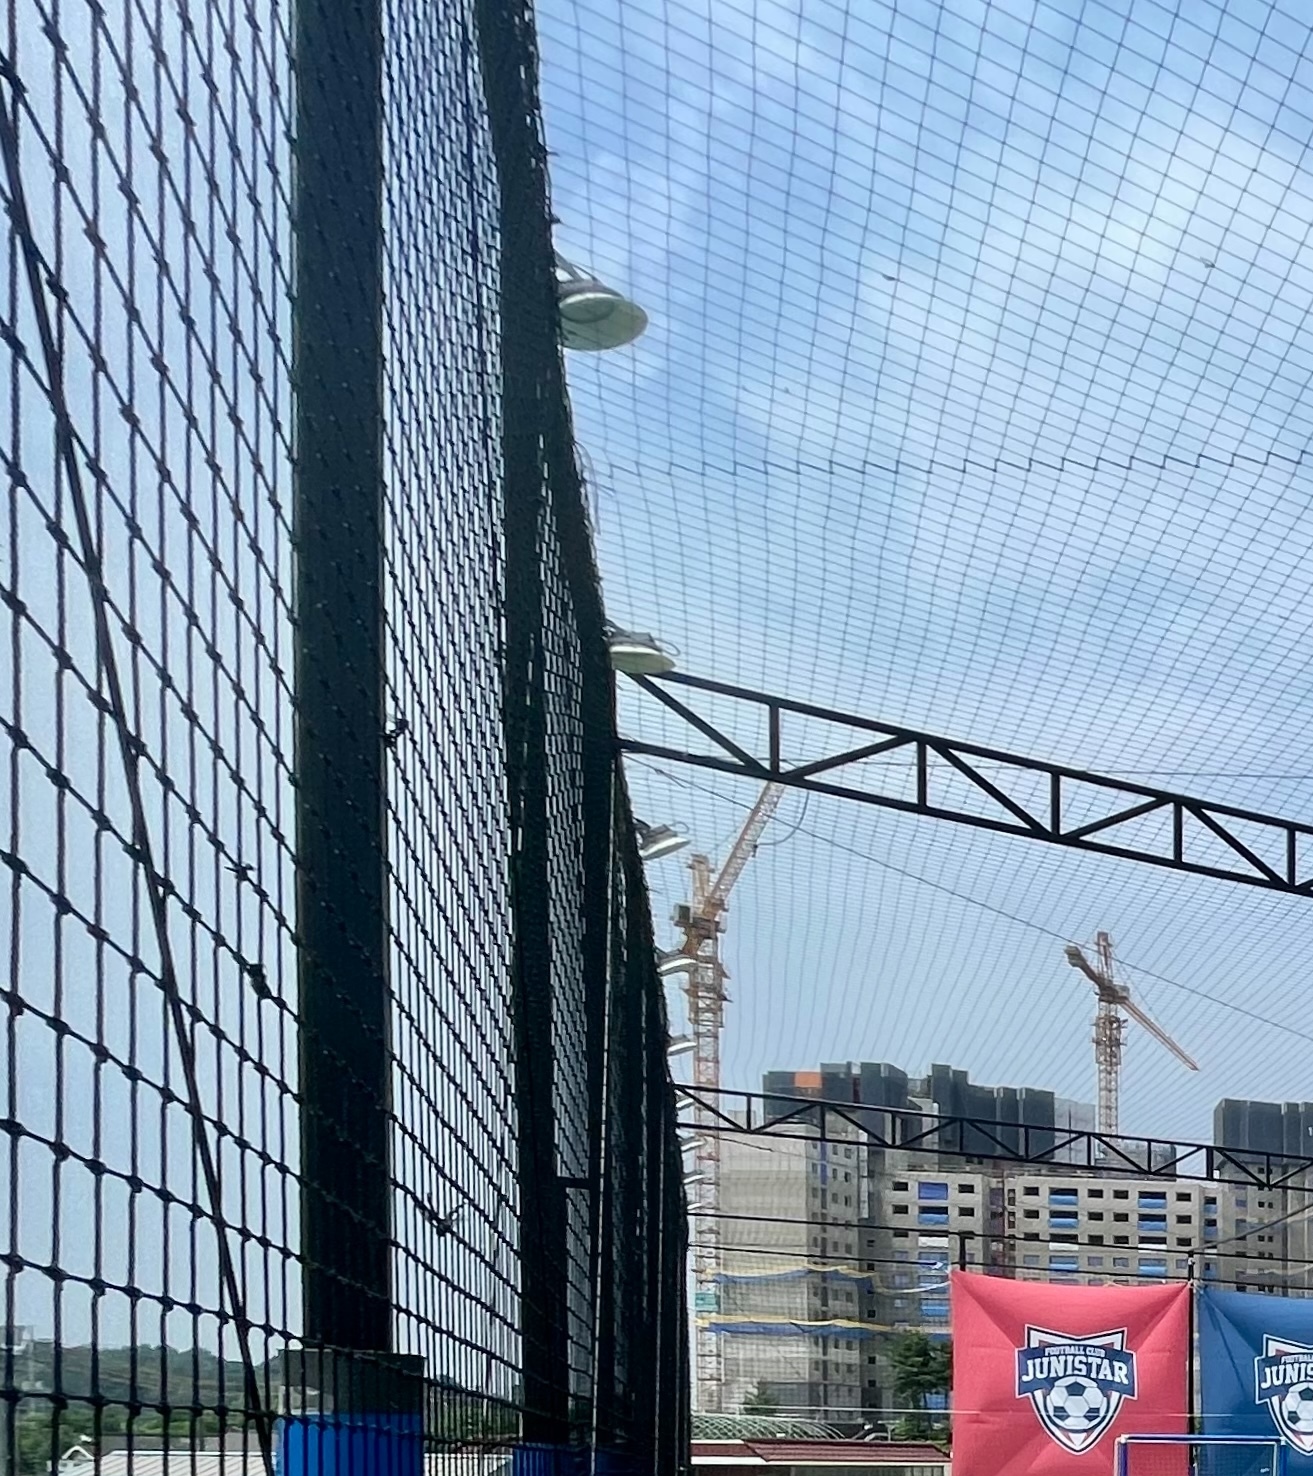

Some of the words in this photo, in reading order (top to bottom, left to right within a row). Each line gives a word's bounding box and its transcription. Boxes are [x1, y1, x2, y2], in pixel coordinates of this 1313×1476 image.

[1044, 1346, 1085, 1356] FOOTBALL
[1086, 1347, 1106, 1357] CLUB
[1021, 1355, 1129, 1385] JUNISTAR
